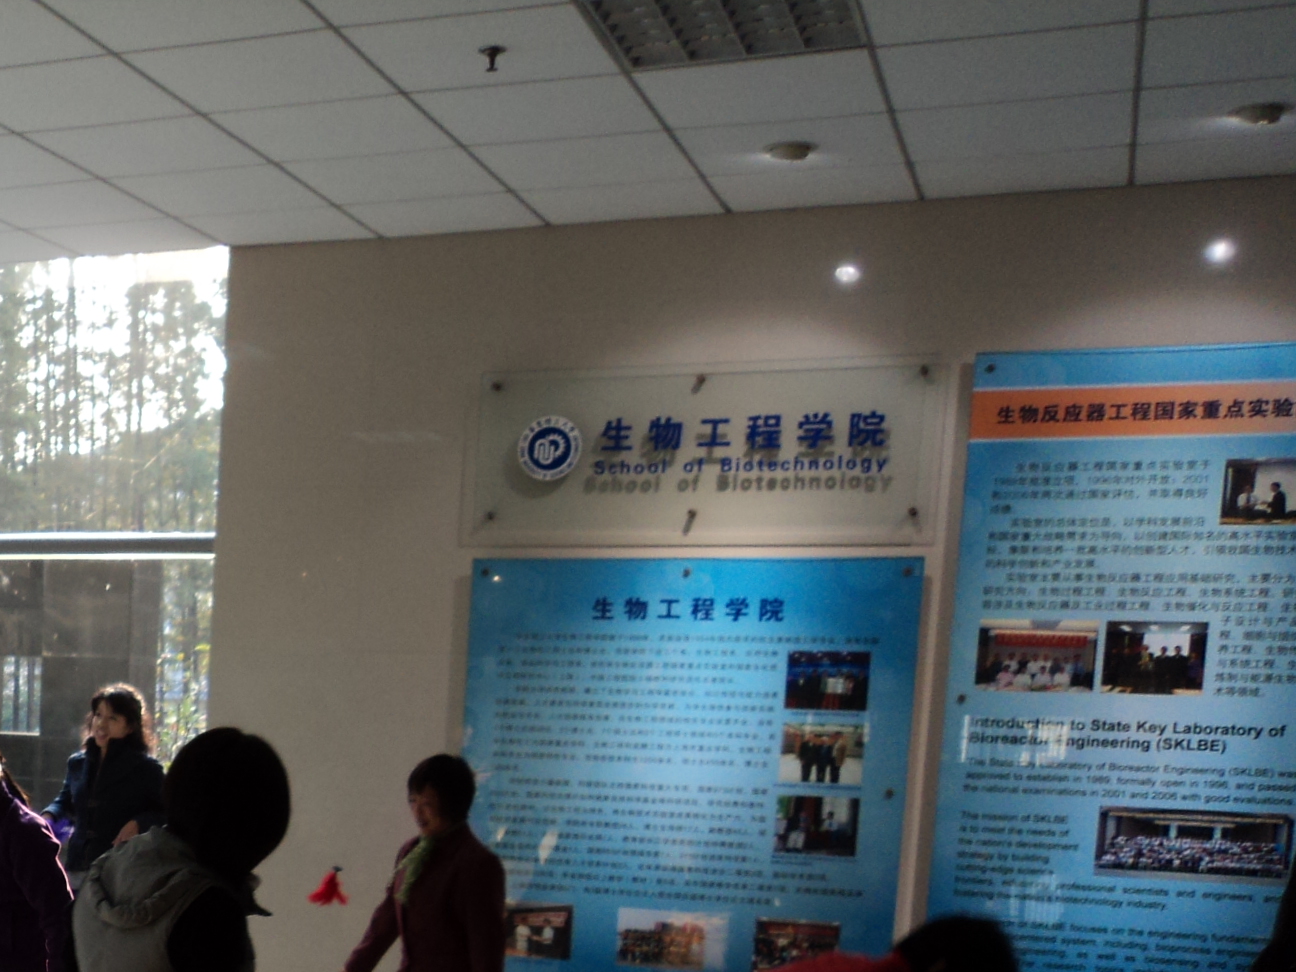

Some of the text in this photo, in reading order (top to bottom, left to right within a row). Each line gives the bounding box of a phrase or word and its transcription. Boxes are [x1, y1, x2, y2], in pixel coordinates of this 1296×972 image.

[601, 410, 887, 452] 生物工程学院
[594, 455, 888, 476] School of Biotechnology
[591, 596, 785, 622] 生物工程学院
[1069, 719, 1085, 731] to
[1090, 719, 1131, 733] State
[1136, 721, 1167, 736] Key
[1172, 721, 1264, 740] Laboratory
[1268, 724, 1287, 738] of
[1156, 737, 1227, 754] (SKLBE)
